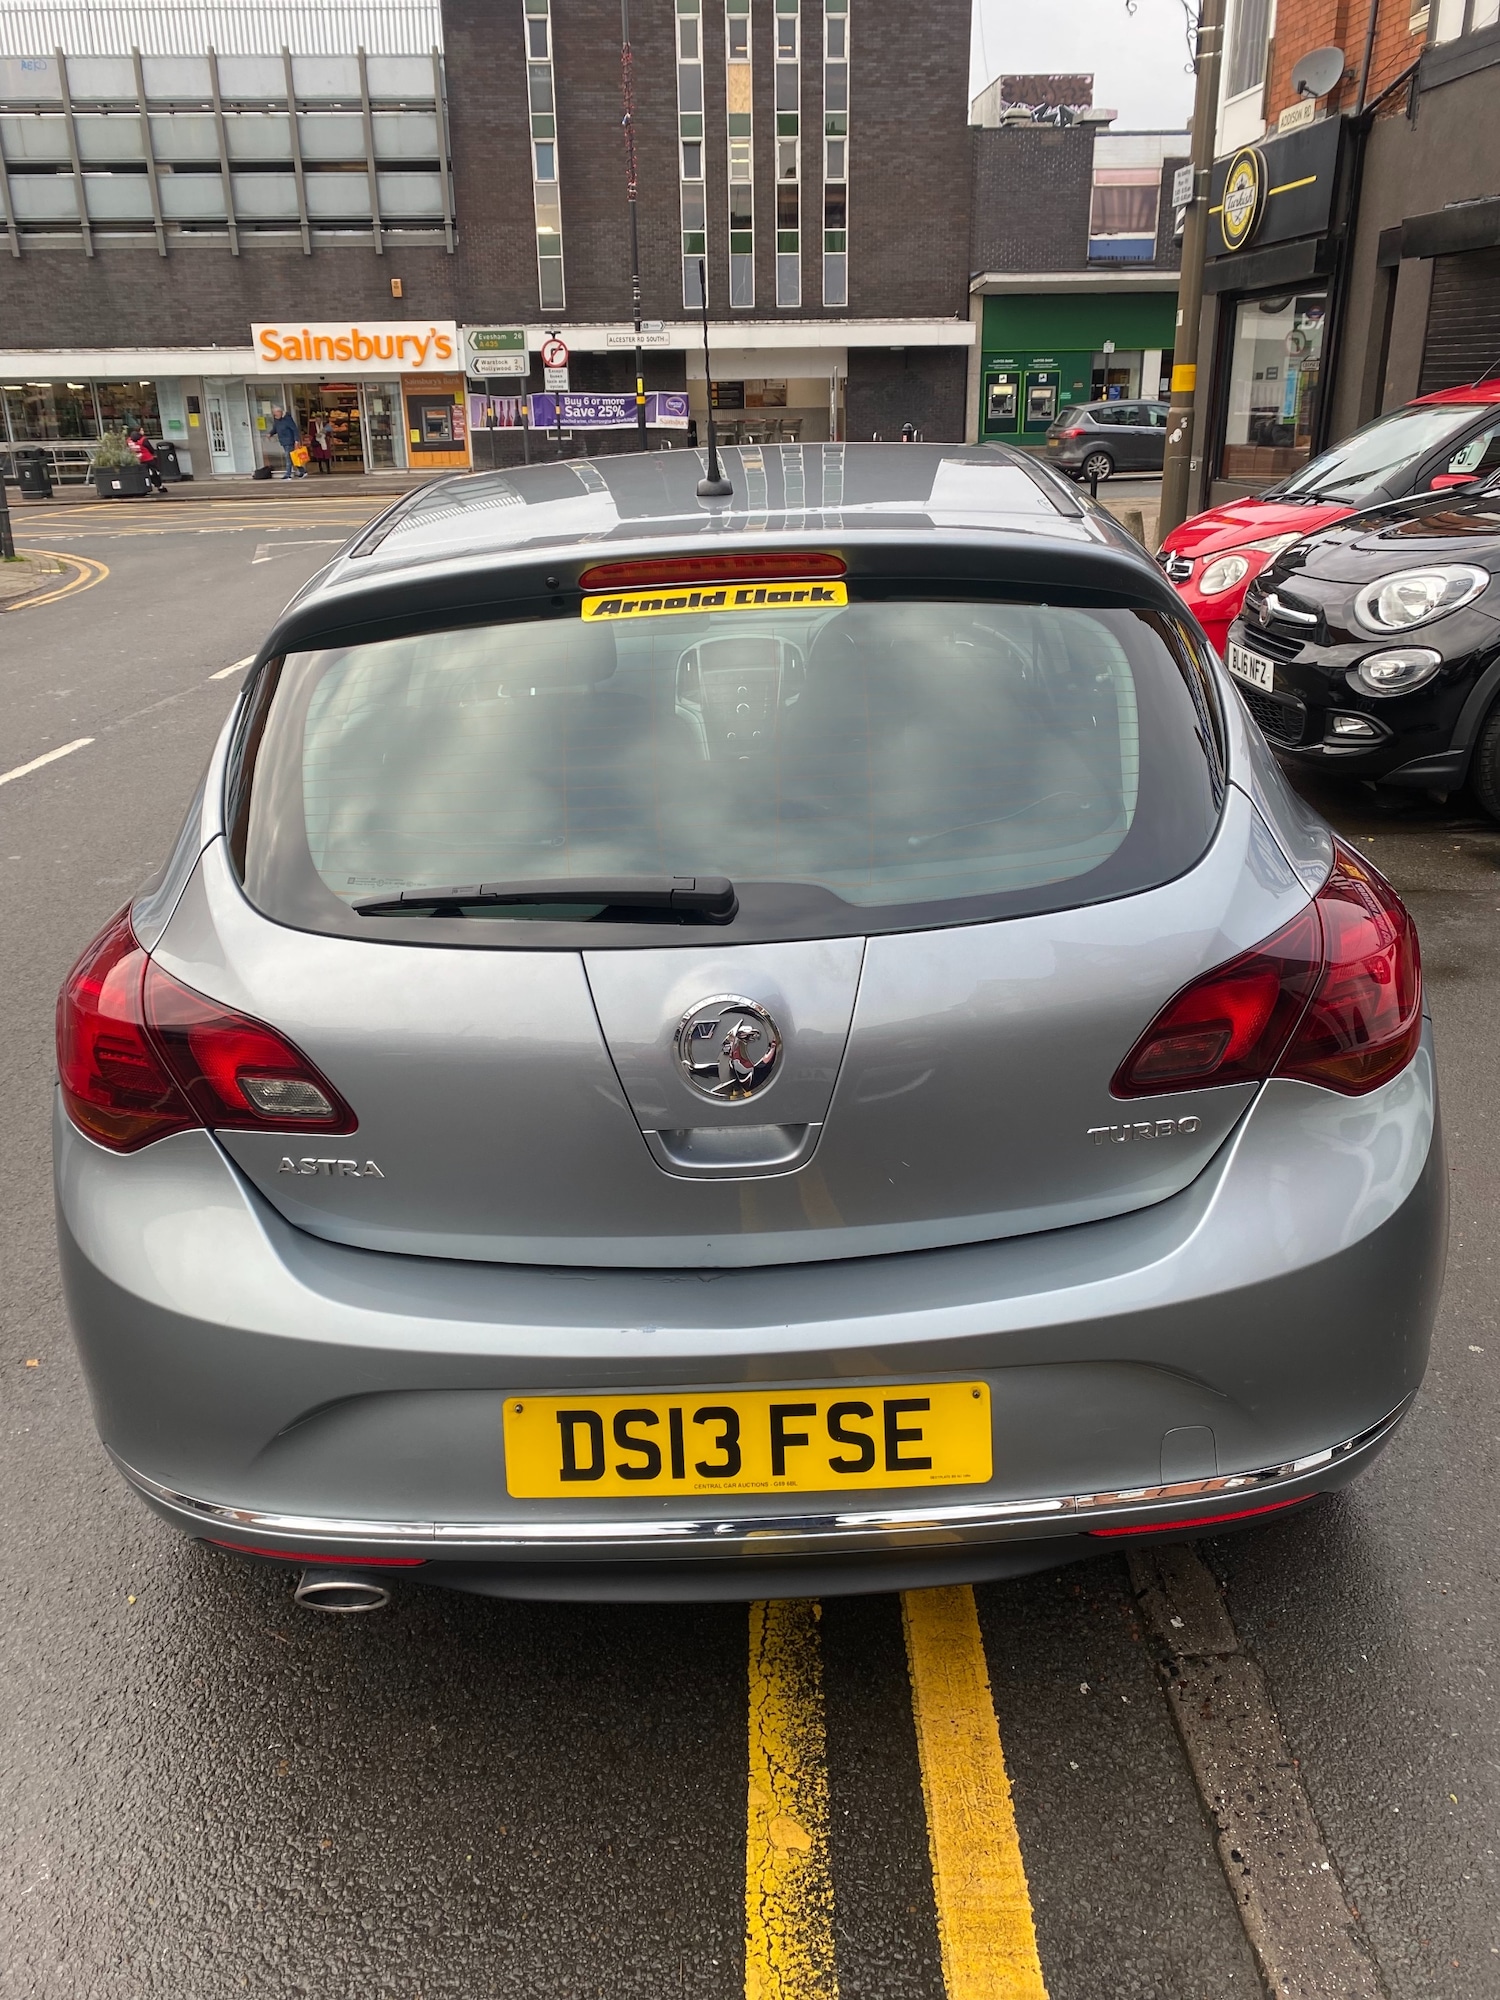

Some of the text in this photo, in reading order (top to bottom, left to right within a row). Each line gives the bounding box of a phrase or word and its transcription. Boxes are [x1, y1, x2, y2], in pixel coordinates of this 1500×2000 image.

[1280, 104, 1311, 128] ADDISON RD
[1228, 188, 1253, 210] Turkish
[260, 328, 452, 367] Sainsbury's
[513, 332, 522, 340] 26
[564, 397, 582, 406] Buy
[583, 397, 590, 405] 6
[565, 405, 625, 417] Save 25%
[591, 587, 836, 616] Arnold Clark
[1232, 646, 1267, 685] BL16 NFZ
[1087, 1115, 1201, 1145] TURBO
[276, 1157, 385, 1178] ASTRA
[556, 1398, 932, 1481] DS13 FSE
